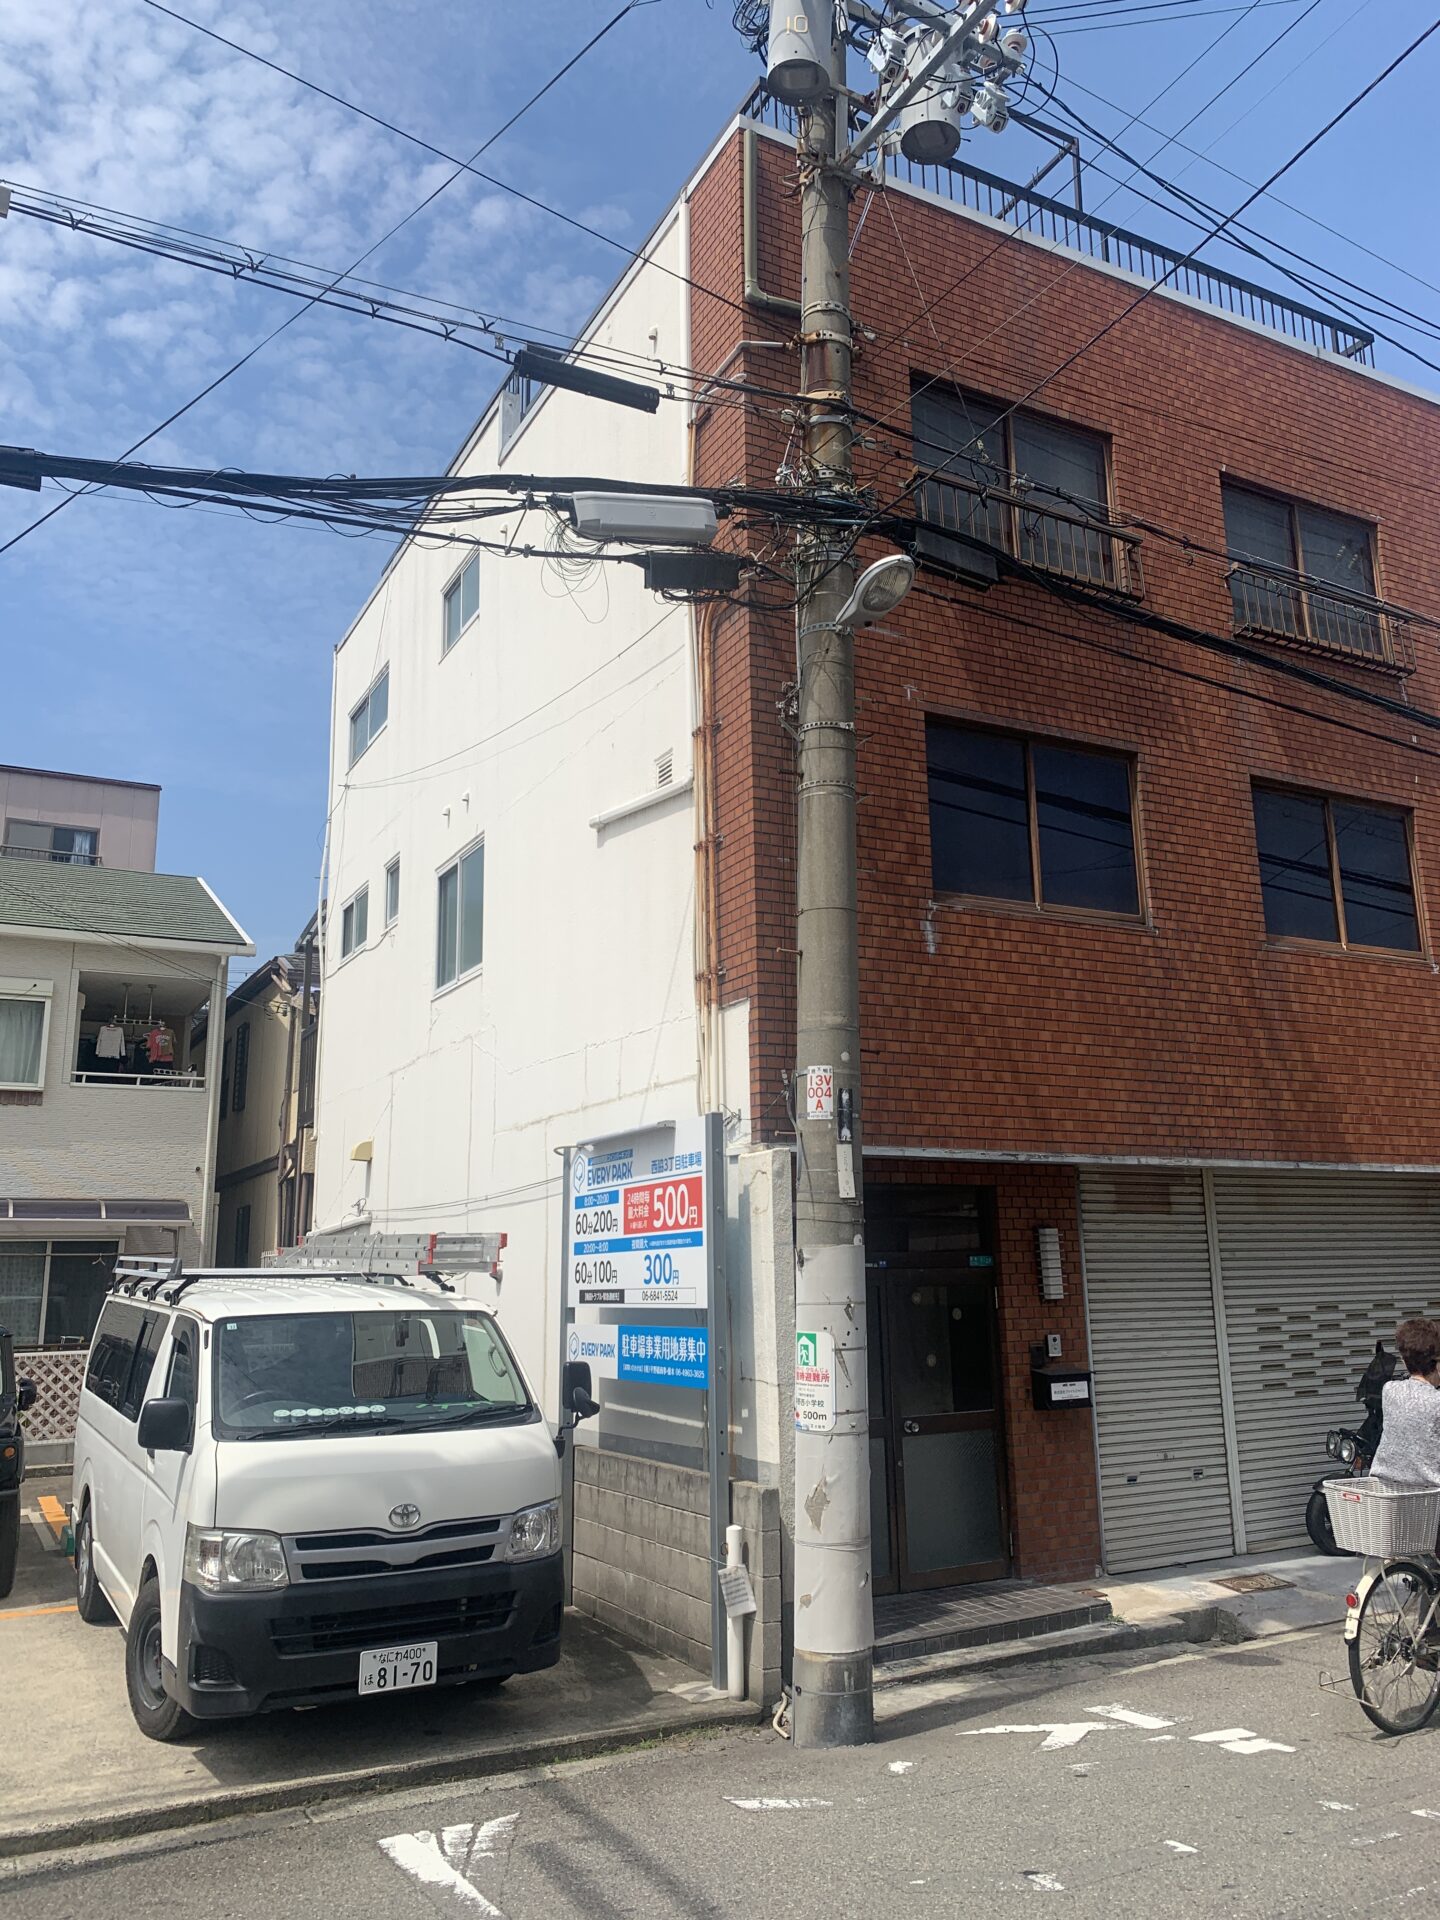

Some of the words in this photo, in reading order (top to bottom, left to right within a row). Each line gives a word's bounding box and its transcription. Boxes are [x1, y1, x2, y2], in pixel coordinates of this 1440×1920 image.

[786, 15, 808, 33] 10
[808, 1087, 832, 1098] 004
[816, 1099, 823, 1110] A
[587, 1165, 613, 1187] EVERY
[612, 1161, 633, 1180] PARK
[653, 1184, 698, 1228] 500円
[576, 1210, 618, 1235] 60分200円
[575, 1260, 617, 1285] 60分100円
[643, 1253, 679, 1285] 300円
[581, 1342, 600, 1357] EVERY
[600, 1343, 616, 1358] PARK
[621, 1333, 706, 1363] 駐車場事業用地募集中
[803, 1411, 827, 1420] 500m
[364, 1674, 374, 1685] ほ
[377, 1660, 433, 1688] 81-70
